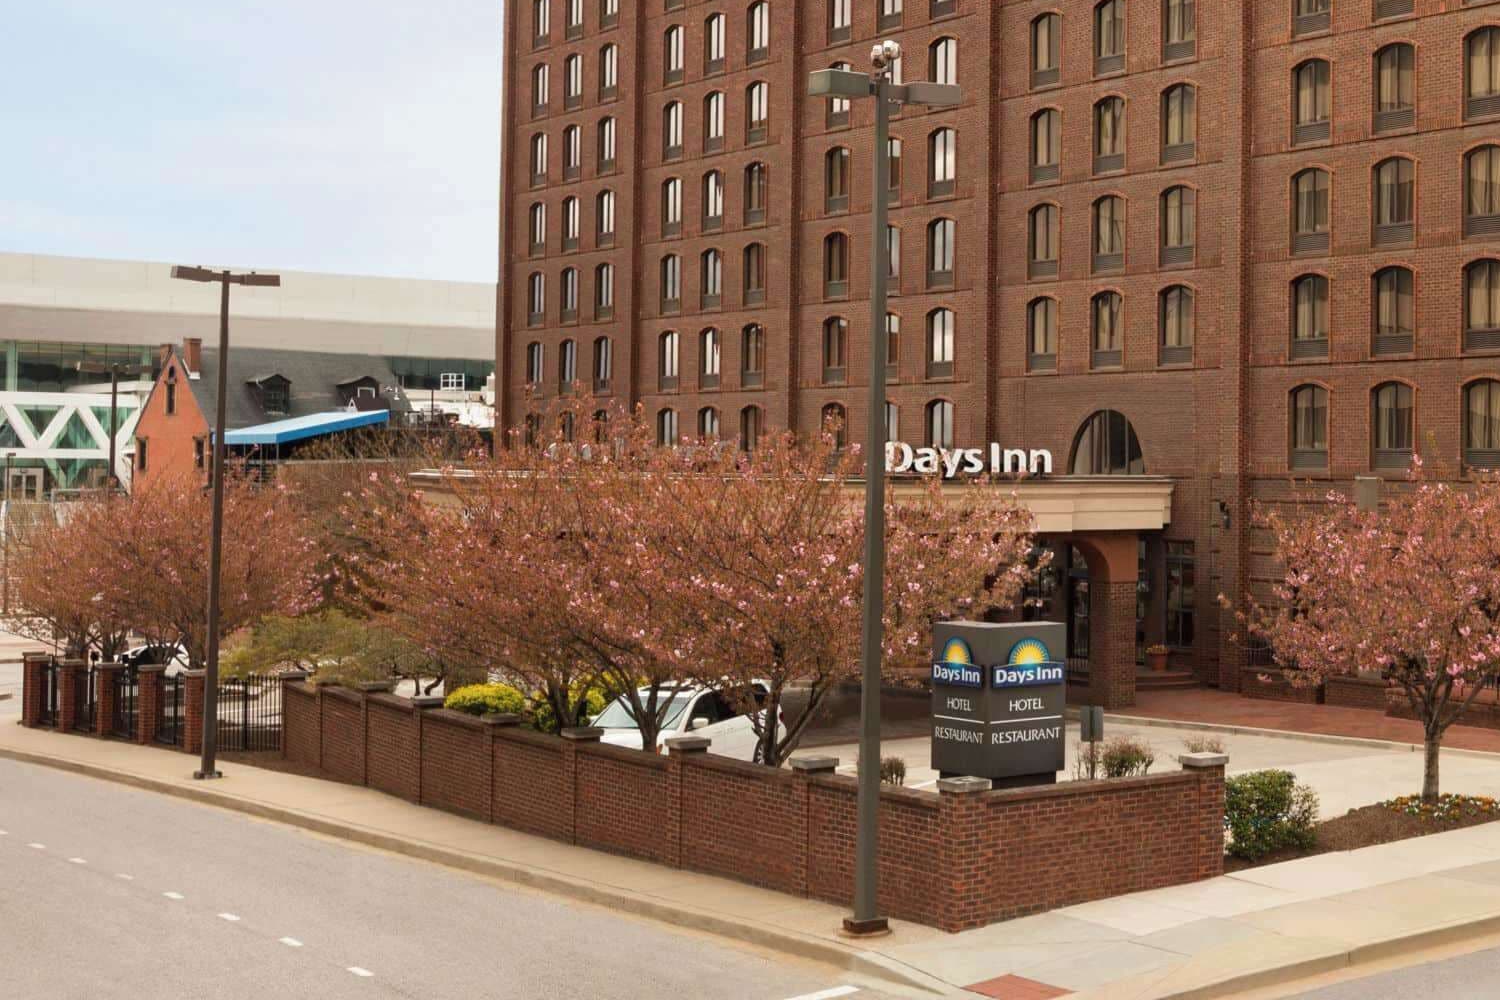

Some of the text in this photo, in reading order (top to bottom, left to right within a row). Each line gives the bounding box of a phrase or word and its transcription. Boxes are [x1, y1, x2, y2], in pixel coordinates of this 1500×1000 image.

[884, 441, 1053, 478] Days Inn
[933, 664, 980, 683] Days Inn
[995, 667, 1062, 684] Days Inn
[947, 696, 972, 711] HOTEL
[1009, 697, 1044, 712] HOTEL
[934, 726, 984, 744] RESTAURANT
[991, 726, 1060, 745] RESTAURANT
